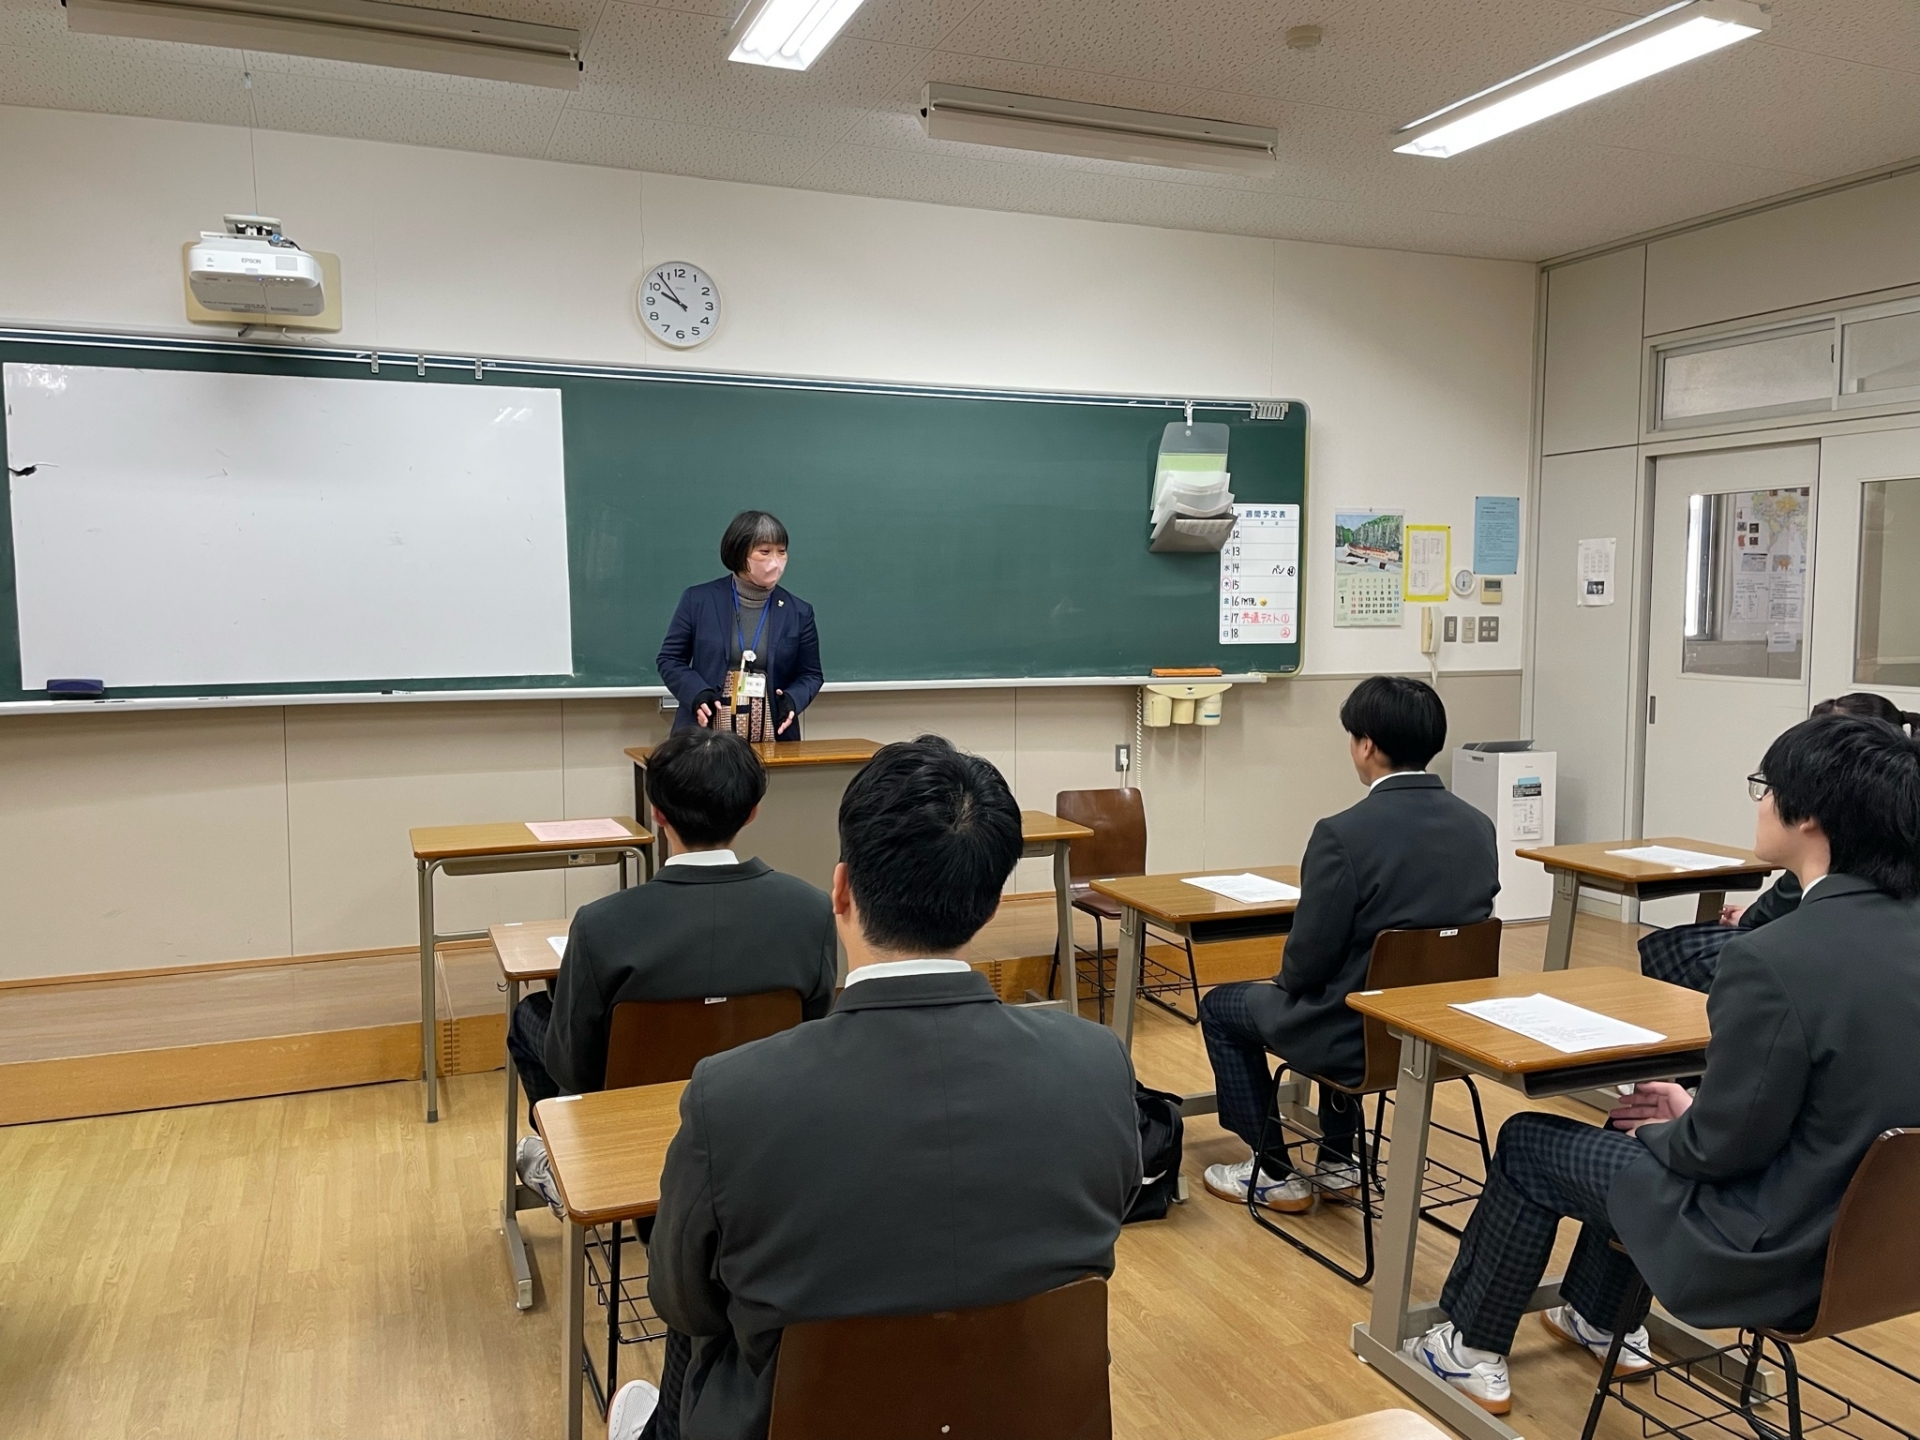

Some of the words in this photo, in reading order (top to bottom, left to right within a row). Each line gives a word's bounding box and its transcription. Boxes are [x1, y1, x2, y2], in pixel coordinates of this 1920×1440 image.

[674, 269, 686, 278] 12
[649, 282, 661, 291] 10
[701, 287, 710, 296] 2
[646, 297, 655, 306] 9
[705, 302, 714, 311] 3
[649, 312, 659, 320] 8
[700, 317, 710, 325] 4
[661, 324, 670, 333] 7
[691, 327, 700, 335] 5
[676, 330, 685, 339] 6
[1246, 510, 1286, 518] 週間予定表
[1233, 530, 1240, 539] 12
[1233, 547, 1240, 556] 13
[1233, 563, 1240, 573] 14
[1233, 580, 1239, 590] 15
[1232, 596, 1239, 606] 16
[1231, 613, 1239, 623] 17
[1231, 628, 1238, 639] 18
